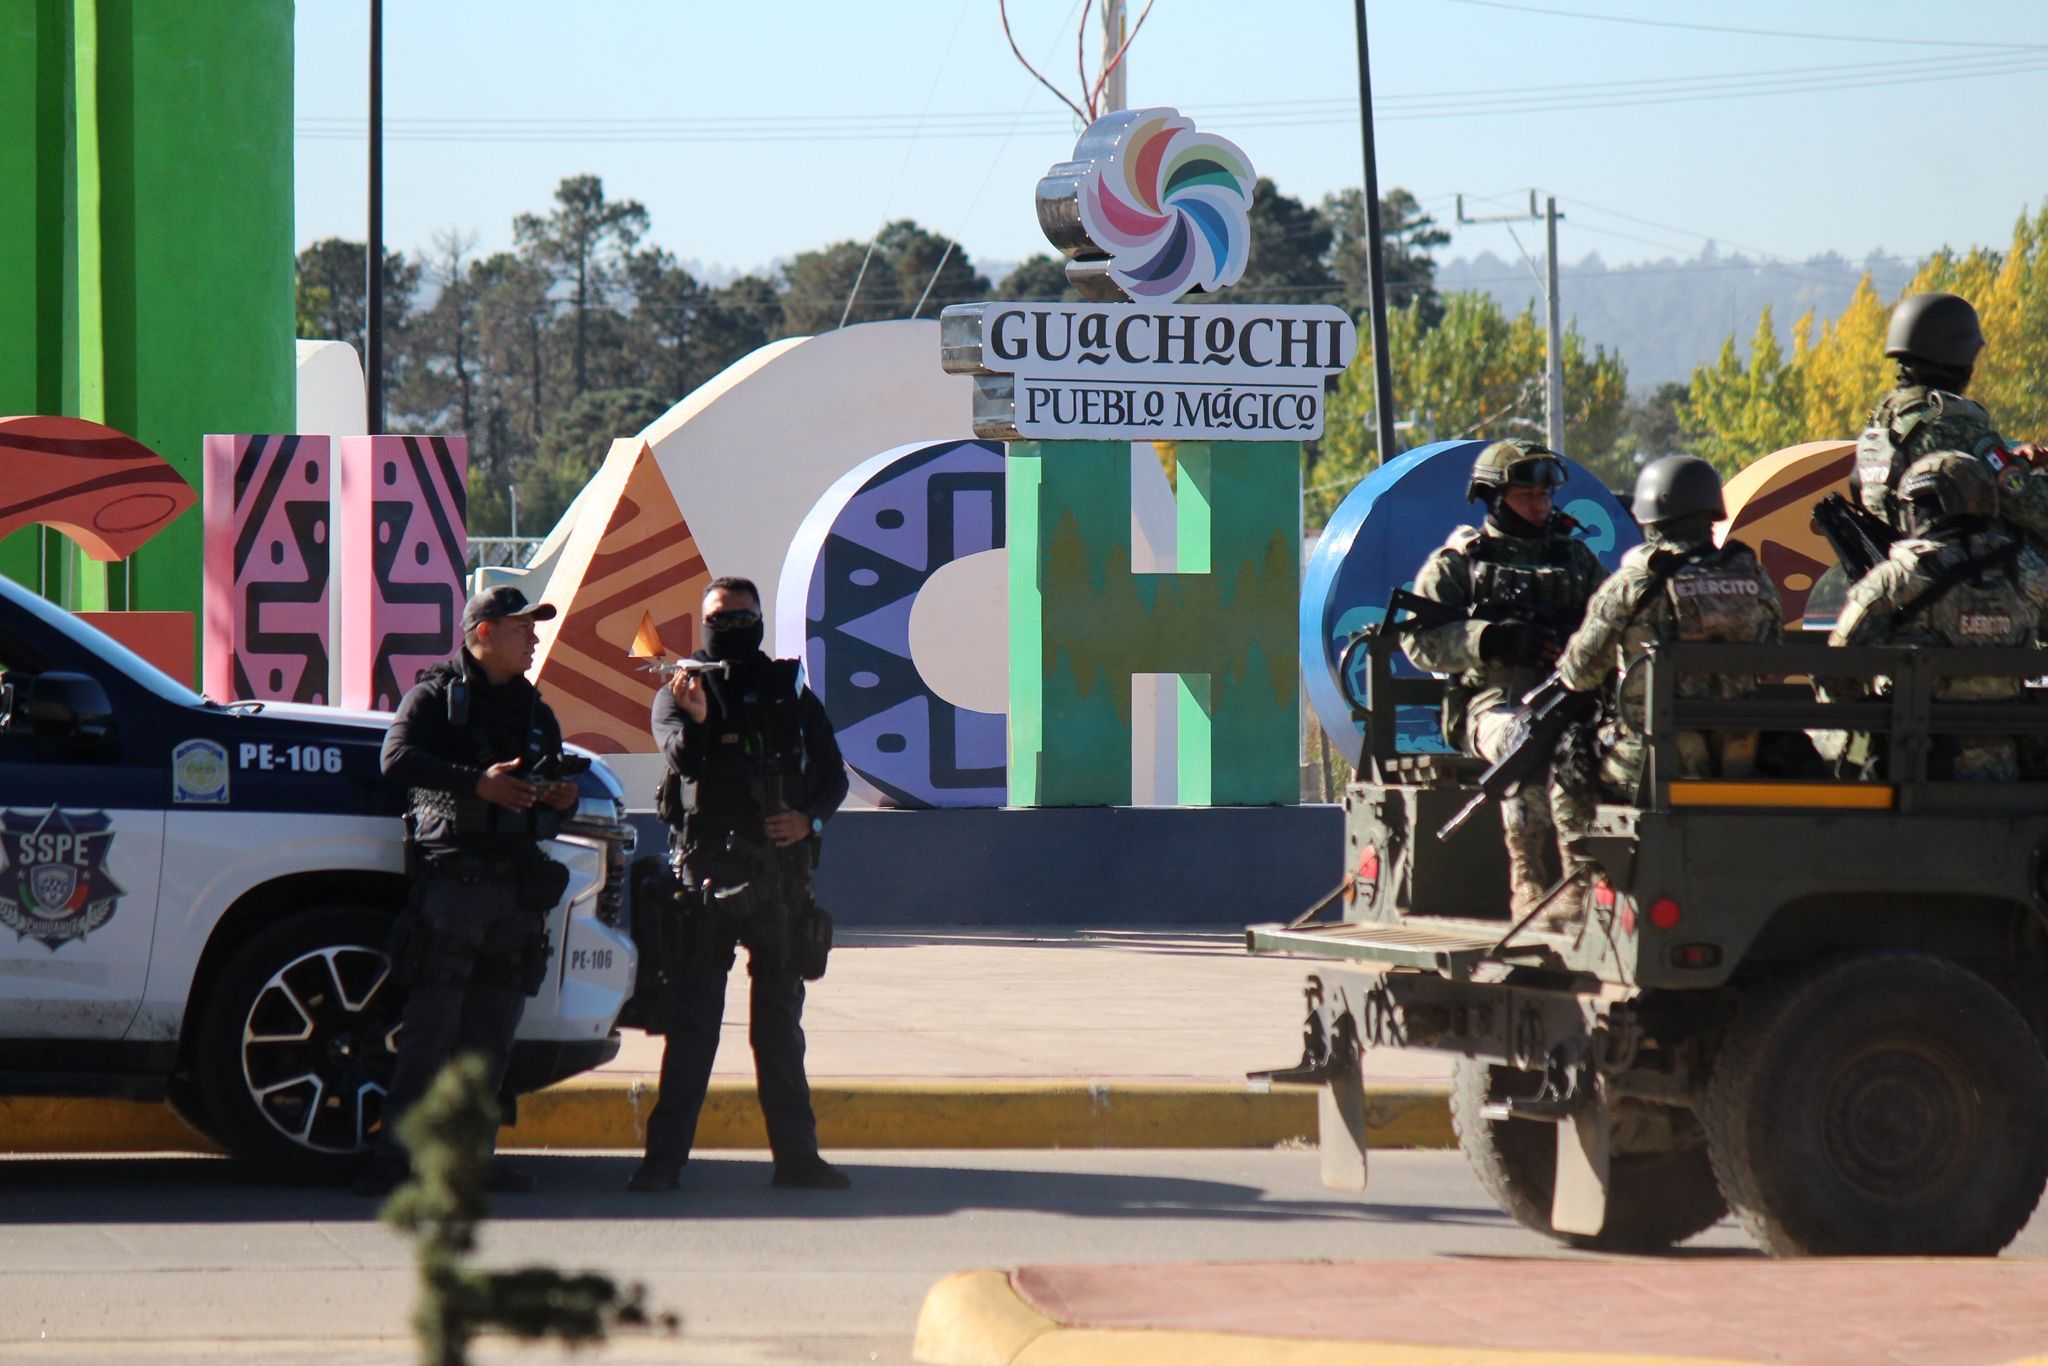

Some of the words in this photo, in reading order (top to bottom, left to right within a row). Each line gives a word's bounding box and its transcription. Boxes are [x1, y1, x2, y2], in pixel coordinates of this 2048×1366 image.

[239, 743, 342, 774] PE-106
[18, 832, 90, 866] SSPE
[571, 949, 613, 970] PE-106
